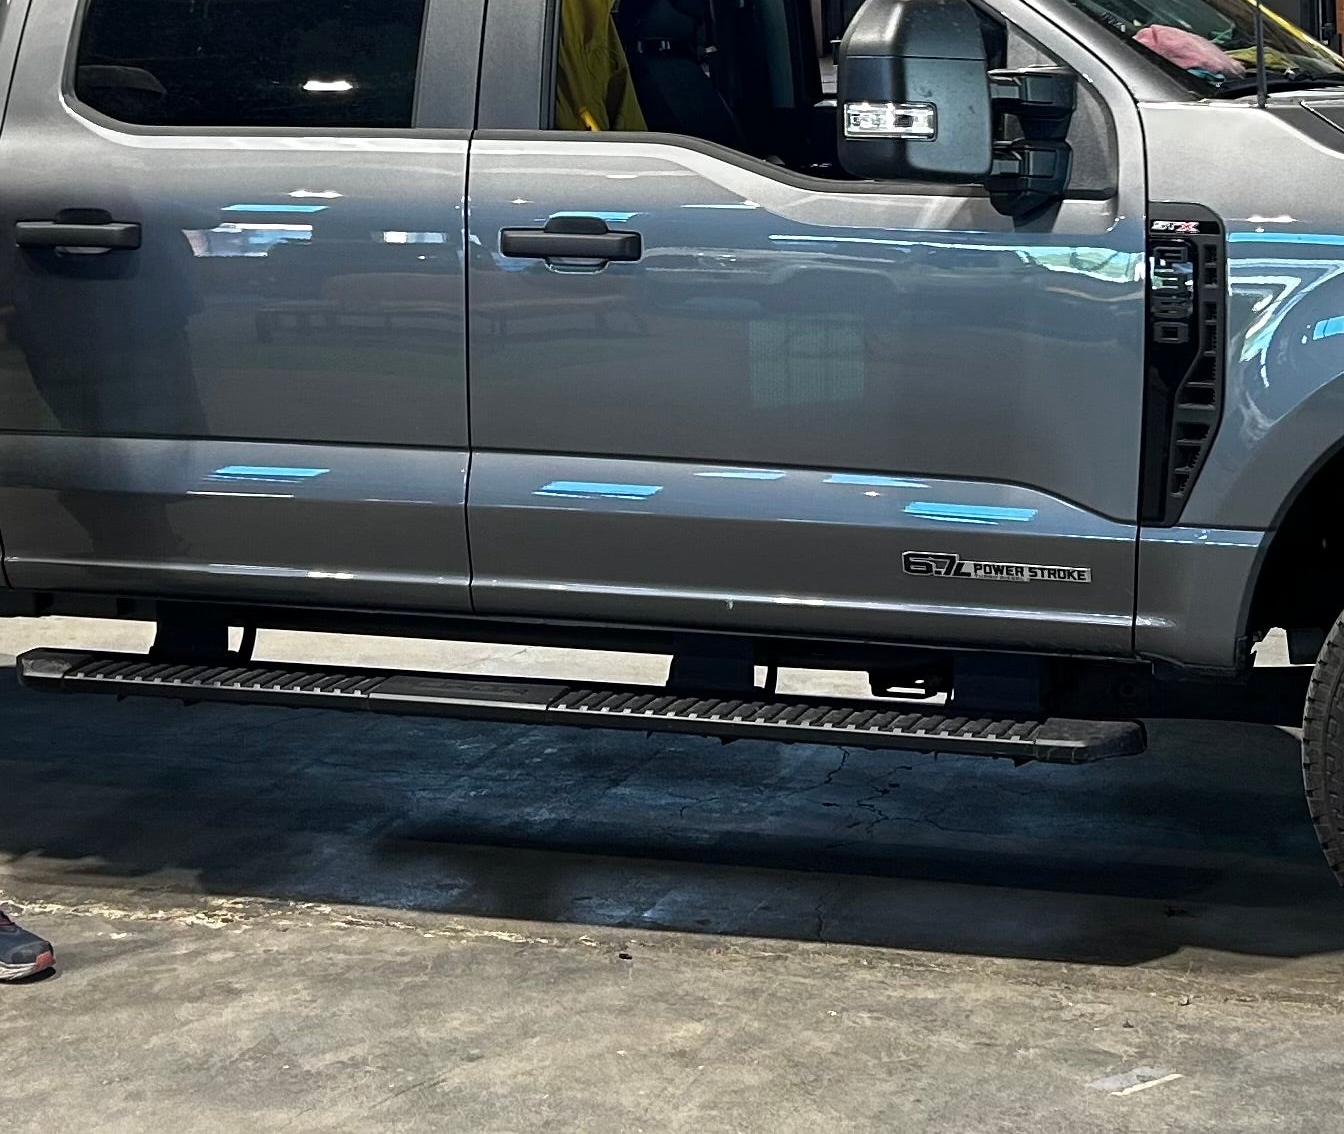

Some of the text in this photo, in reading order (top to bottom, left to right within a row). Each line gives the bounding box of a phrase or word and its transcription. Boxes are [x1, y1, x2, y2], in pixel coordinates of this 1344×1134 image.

[902, 551, 973, 578] 6.7L
[973, 563, 1025, 578] POWER
[1028, 567, 1087, 582] STROKE
